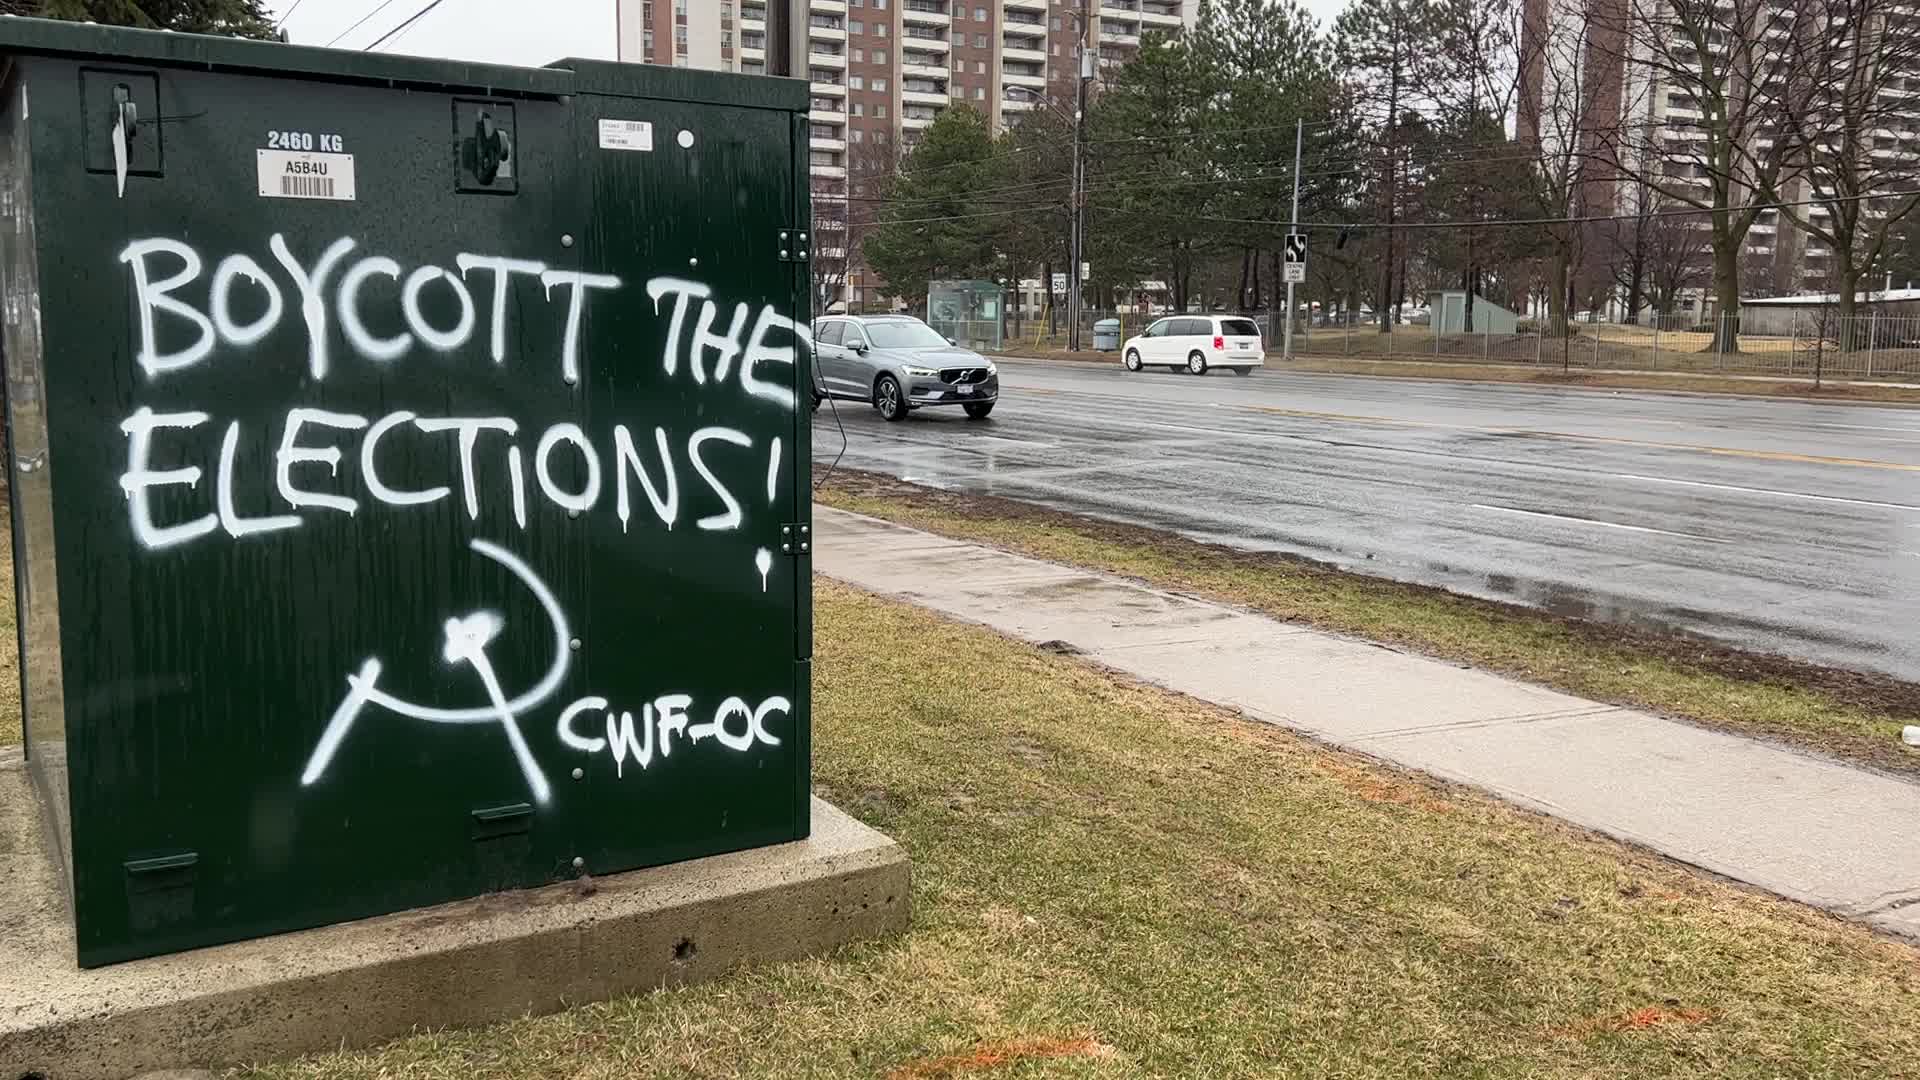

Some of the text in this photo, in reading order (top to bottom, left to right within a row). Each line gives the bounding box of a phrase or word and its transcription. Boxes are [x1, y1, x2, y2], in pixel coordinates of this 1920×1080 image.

[268, 130, 343, 152] 2460 KG
[286, 161, 328, 175] A5B4U
[1054, 281, 1065, 290] 50
[119, 232, 815, 411] BOYCOTT THE
[119, 405, 783, 593] ELECTIONS!
[557, 693, 791, 779] CWF-OC
